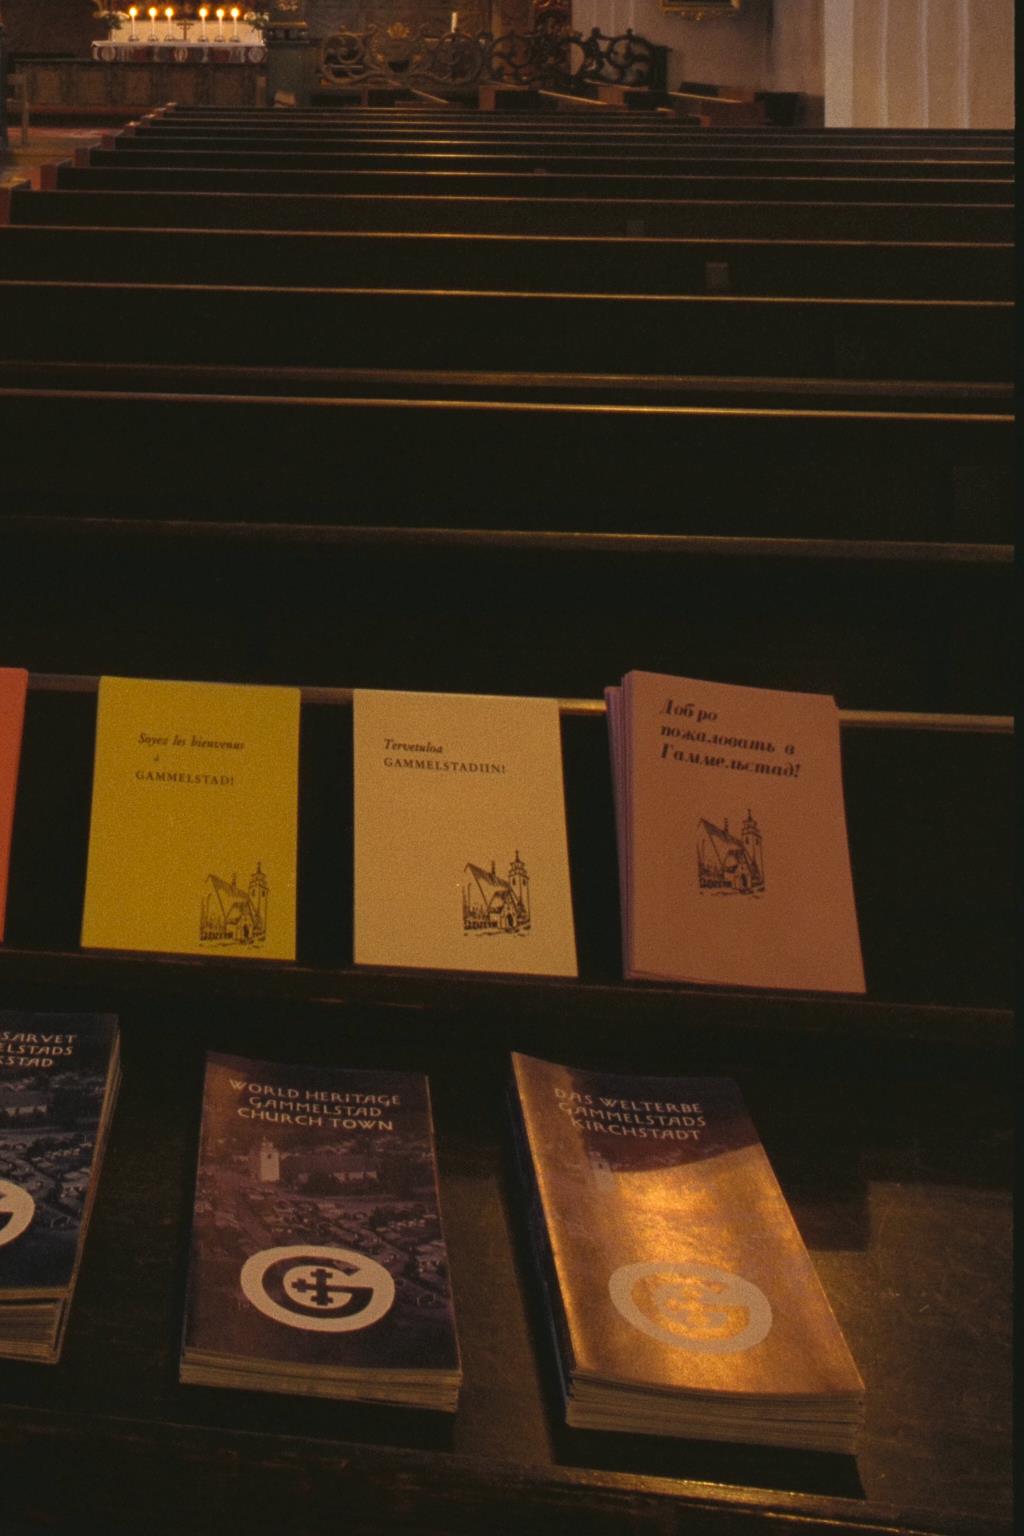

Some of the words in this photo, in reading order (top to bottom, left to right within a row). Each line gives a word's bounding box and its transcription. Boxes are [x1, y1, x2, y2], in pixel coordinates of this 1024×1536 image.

[137, 732, 169, 748] Soyez
[173, 733, 186, 747] les
[190, 734, 245, 751] bienvenus
[383, 738, 444, 754] Tervetuloa
[383, 757, 506, 774] GAMMELSTADIIN!
[135, 769, 235, 786] GAMMELSTAD!
[229, 1078, 300, 1099] WORLD
[305, 1090, 401, 1107] HERITAGE
[554, 1087, 593, 1105] DAS
[600, 1096, 703, 1114] WELTERBE
[248, 1096, 383, 1118] GAMMELSTAD
[559, 1102, 707, 1127] GAMMELSTADS
[237, 1107, 323, 1127] CHURCH
[328, 1117, 394, 1131] TOWN
[570, 1116, 702, 1141] KIRCHSTADT
